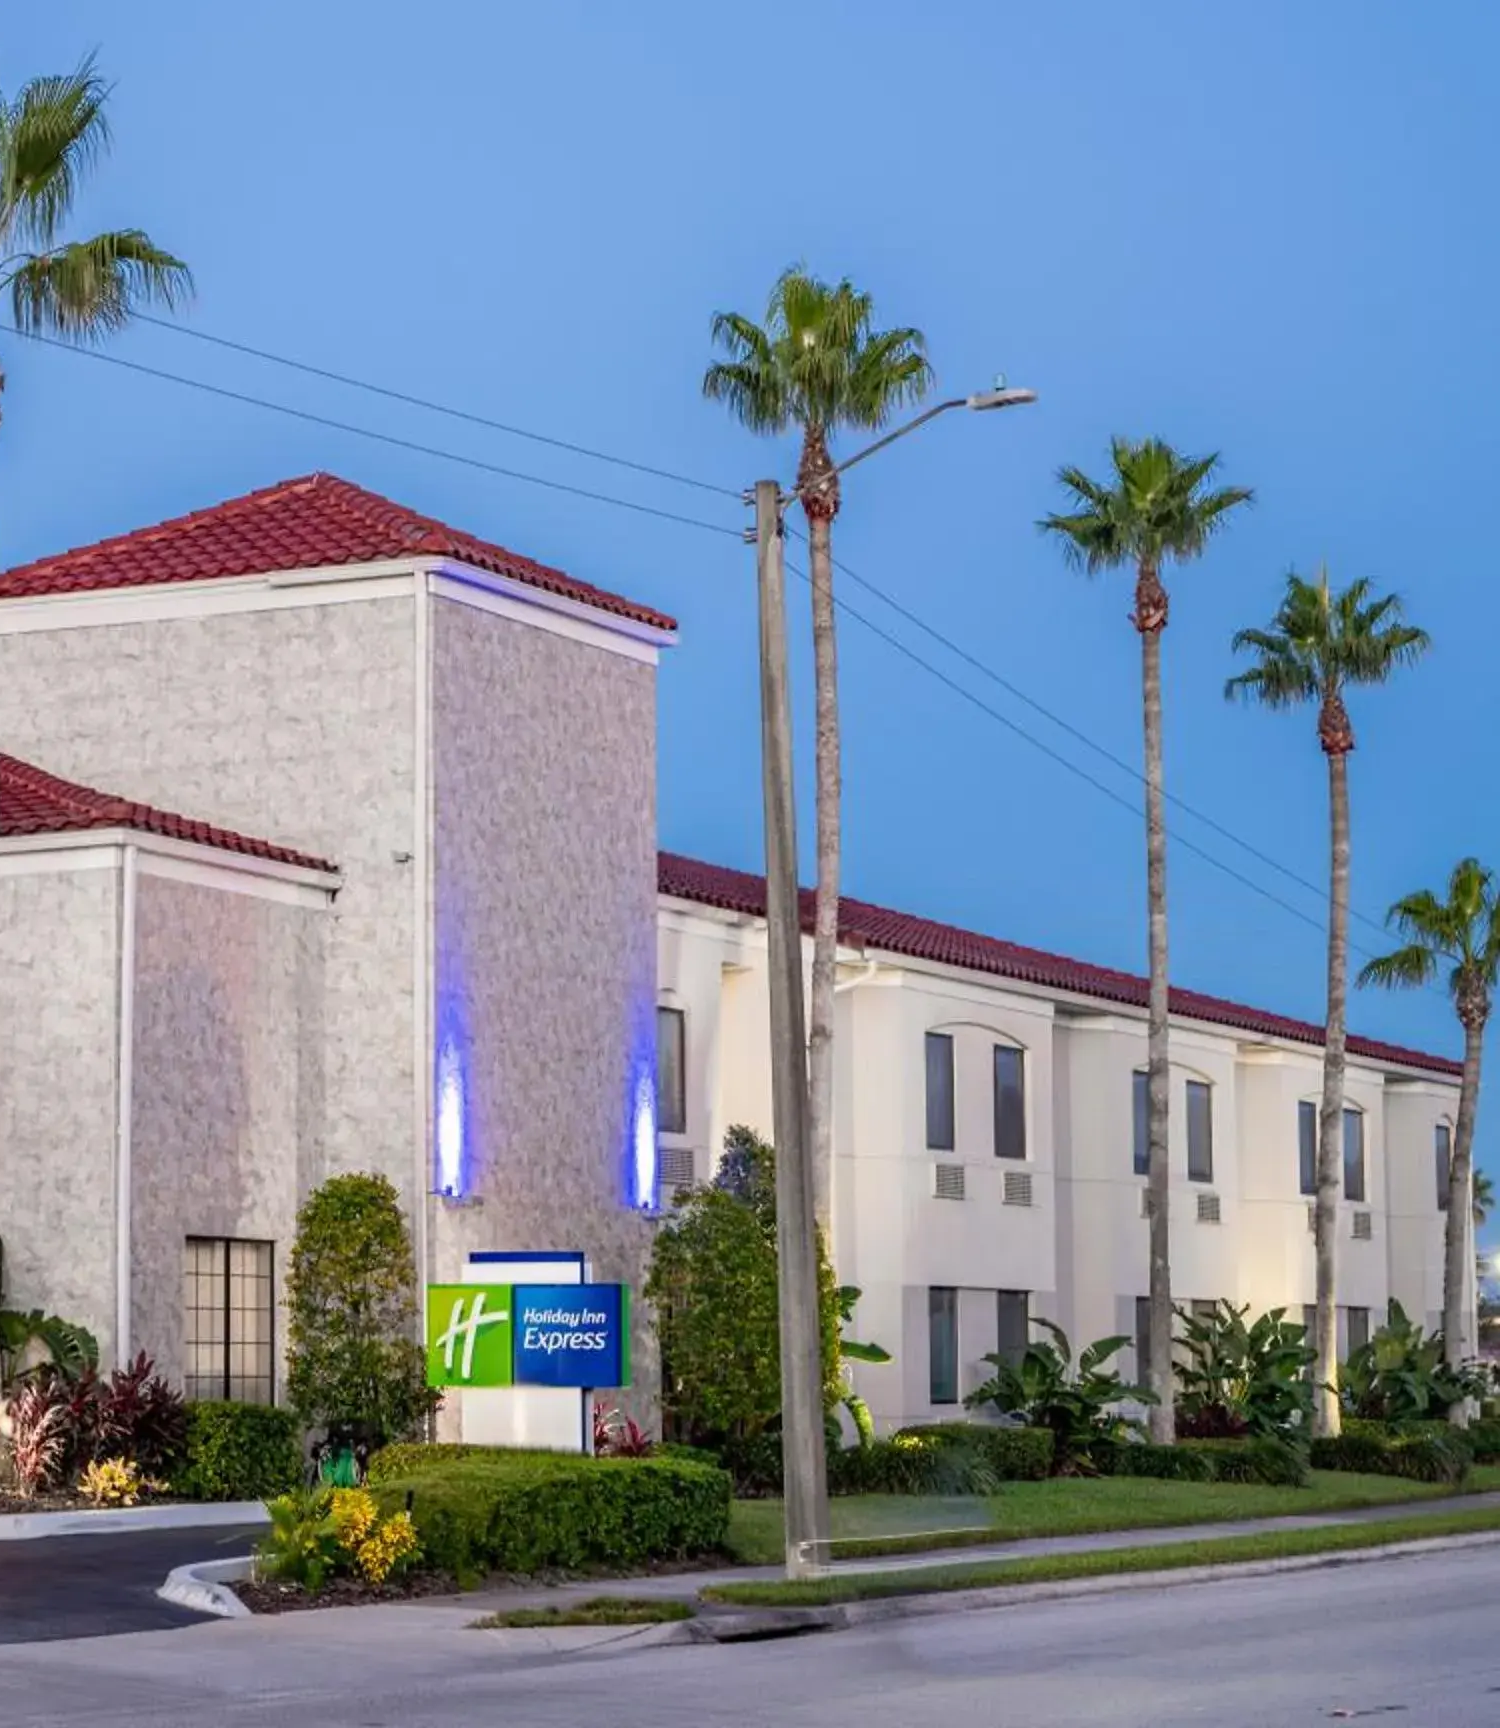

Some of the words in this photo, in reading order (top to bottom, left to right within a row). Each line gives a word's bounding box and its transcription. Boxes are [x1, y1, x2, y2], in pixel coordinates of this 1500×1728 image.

[523, 1307, 580, 1328] Holiday
[581, 1308, 606, 1324] Inn
[523, 1327, 606, 1354] Express
